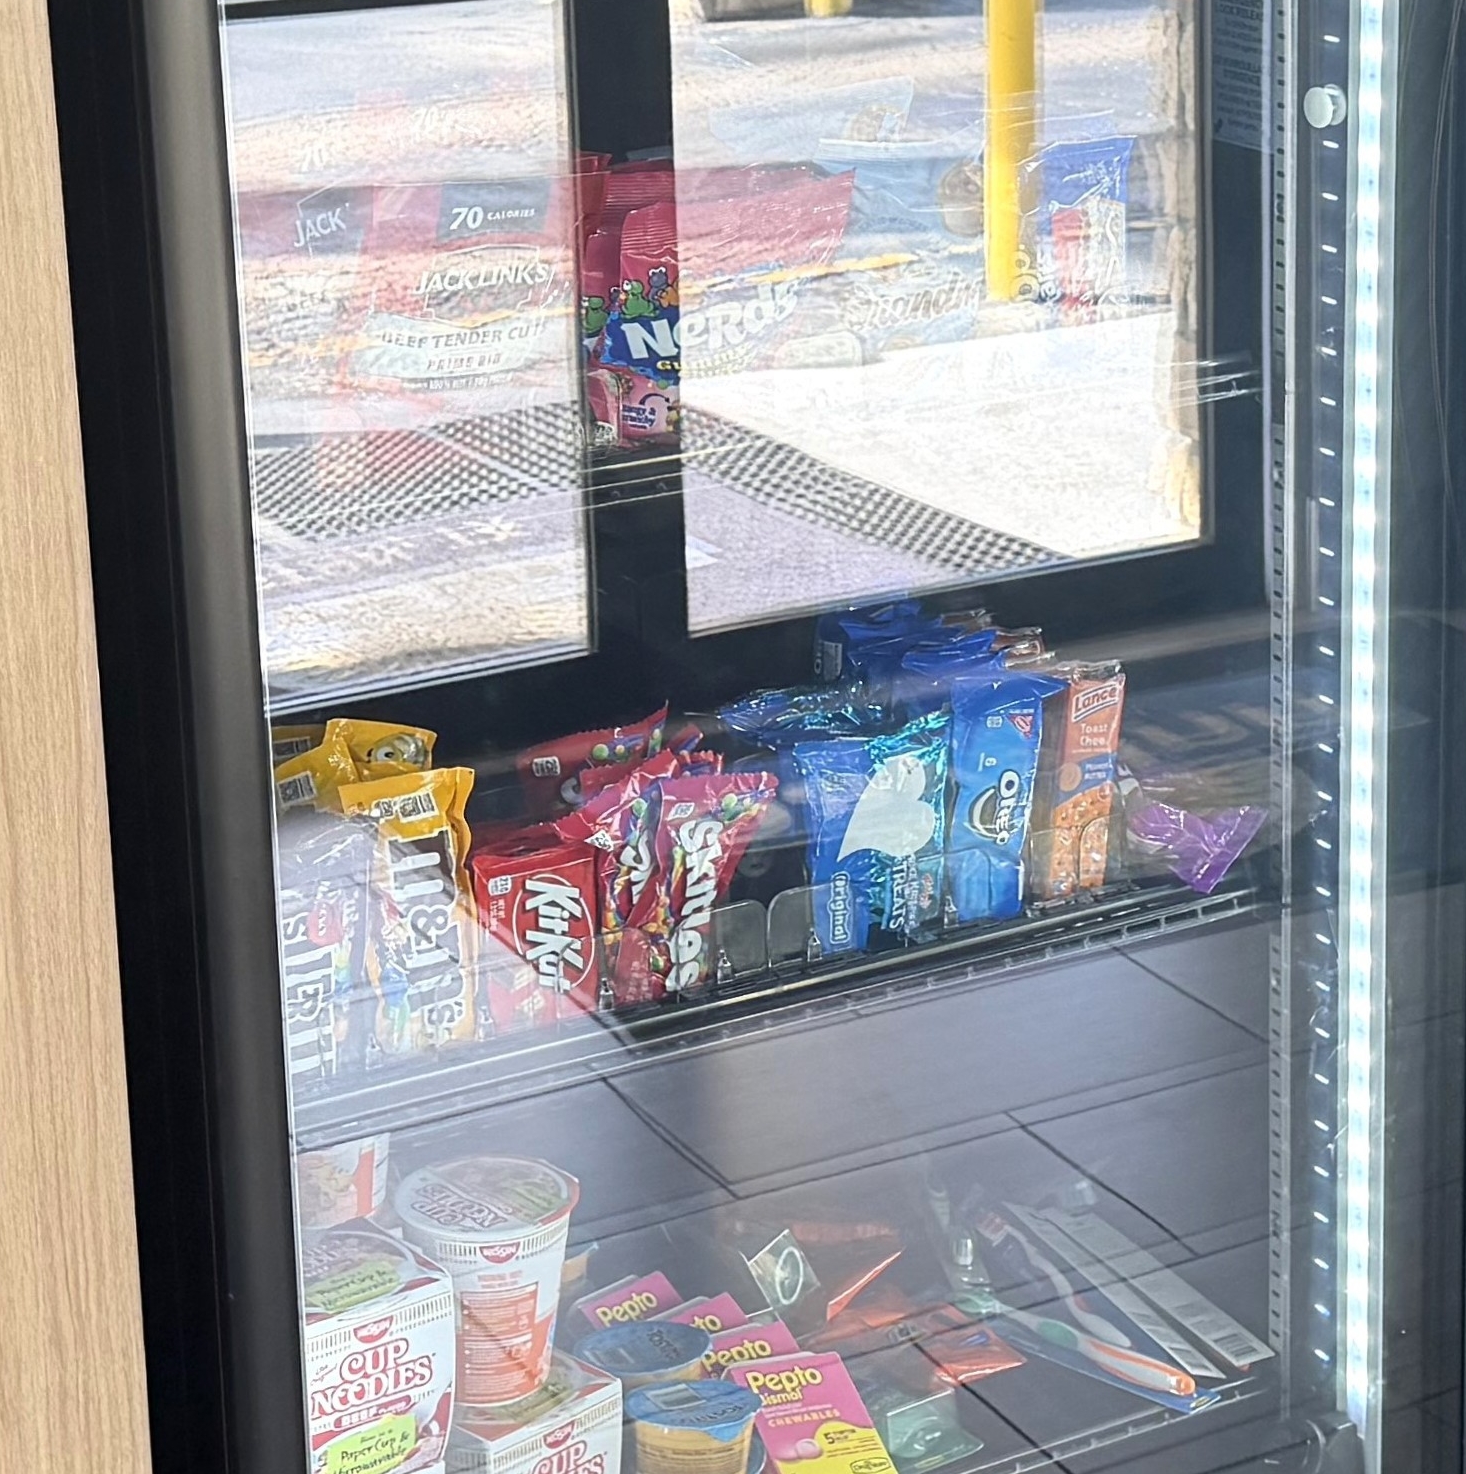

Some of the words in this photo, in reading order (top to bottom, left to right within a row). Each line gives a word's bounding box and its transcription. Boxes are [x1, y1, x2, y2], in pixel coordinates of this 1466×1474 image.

[449, 206, 484, 230] 70
[412, 268, 474, 294] JACK
[382, 332, 429, 349] BEEF
[433, 329, 503, 348] TENDER
[1075, 687, 1118, 713] Lance
[1080, 723, 1108, 734] Toast
[888, 860, 906, 930] TREATS
[596, 1291, 658, 1328] Pepto
[340, 1338, 409, 1383] CUP
[701, 1339, 772, 1372] Pepto
[311, 1355, 433, 1421] NOODLES
[745, 1365, 823, 1395] Pepto
[767, 1409, 841, 1428] CHEWABLES
[531, 1440, 588, 1474] CUP
